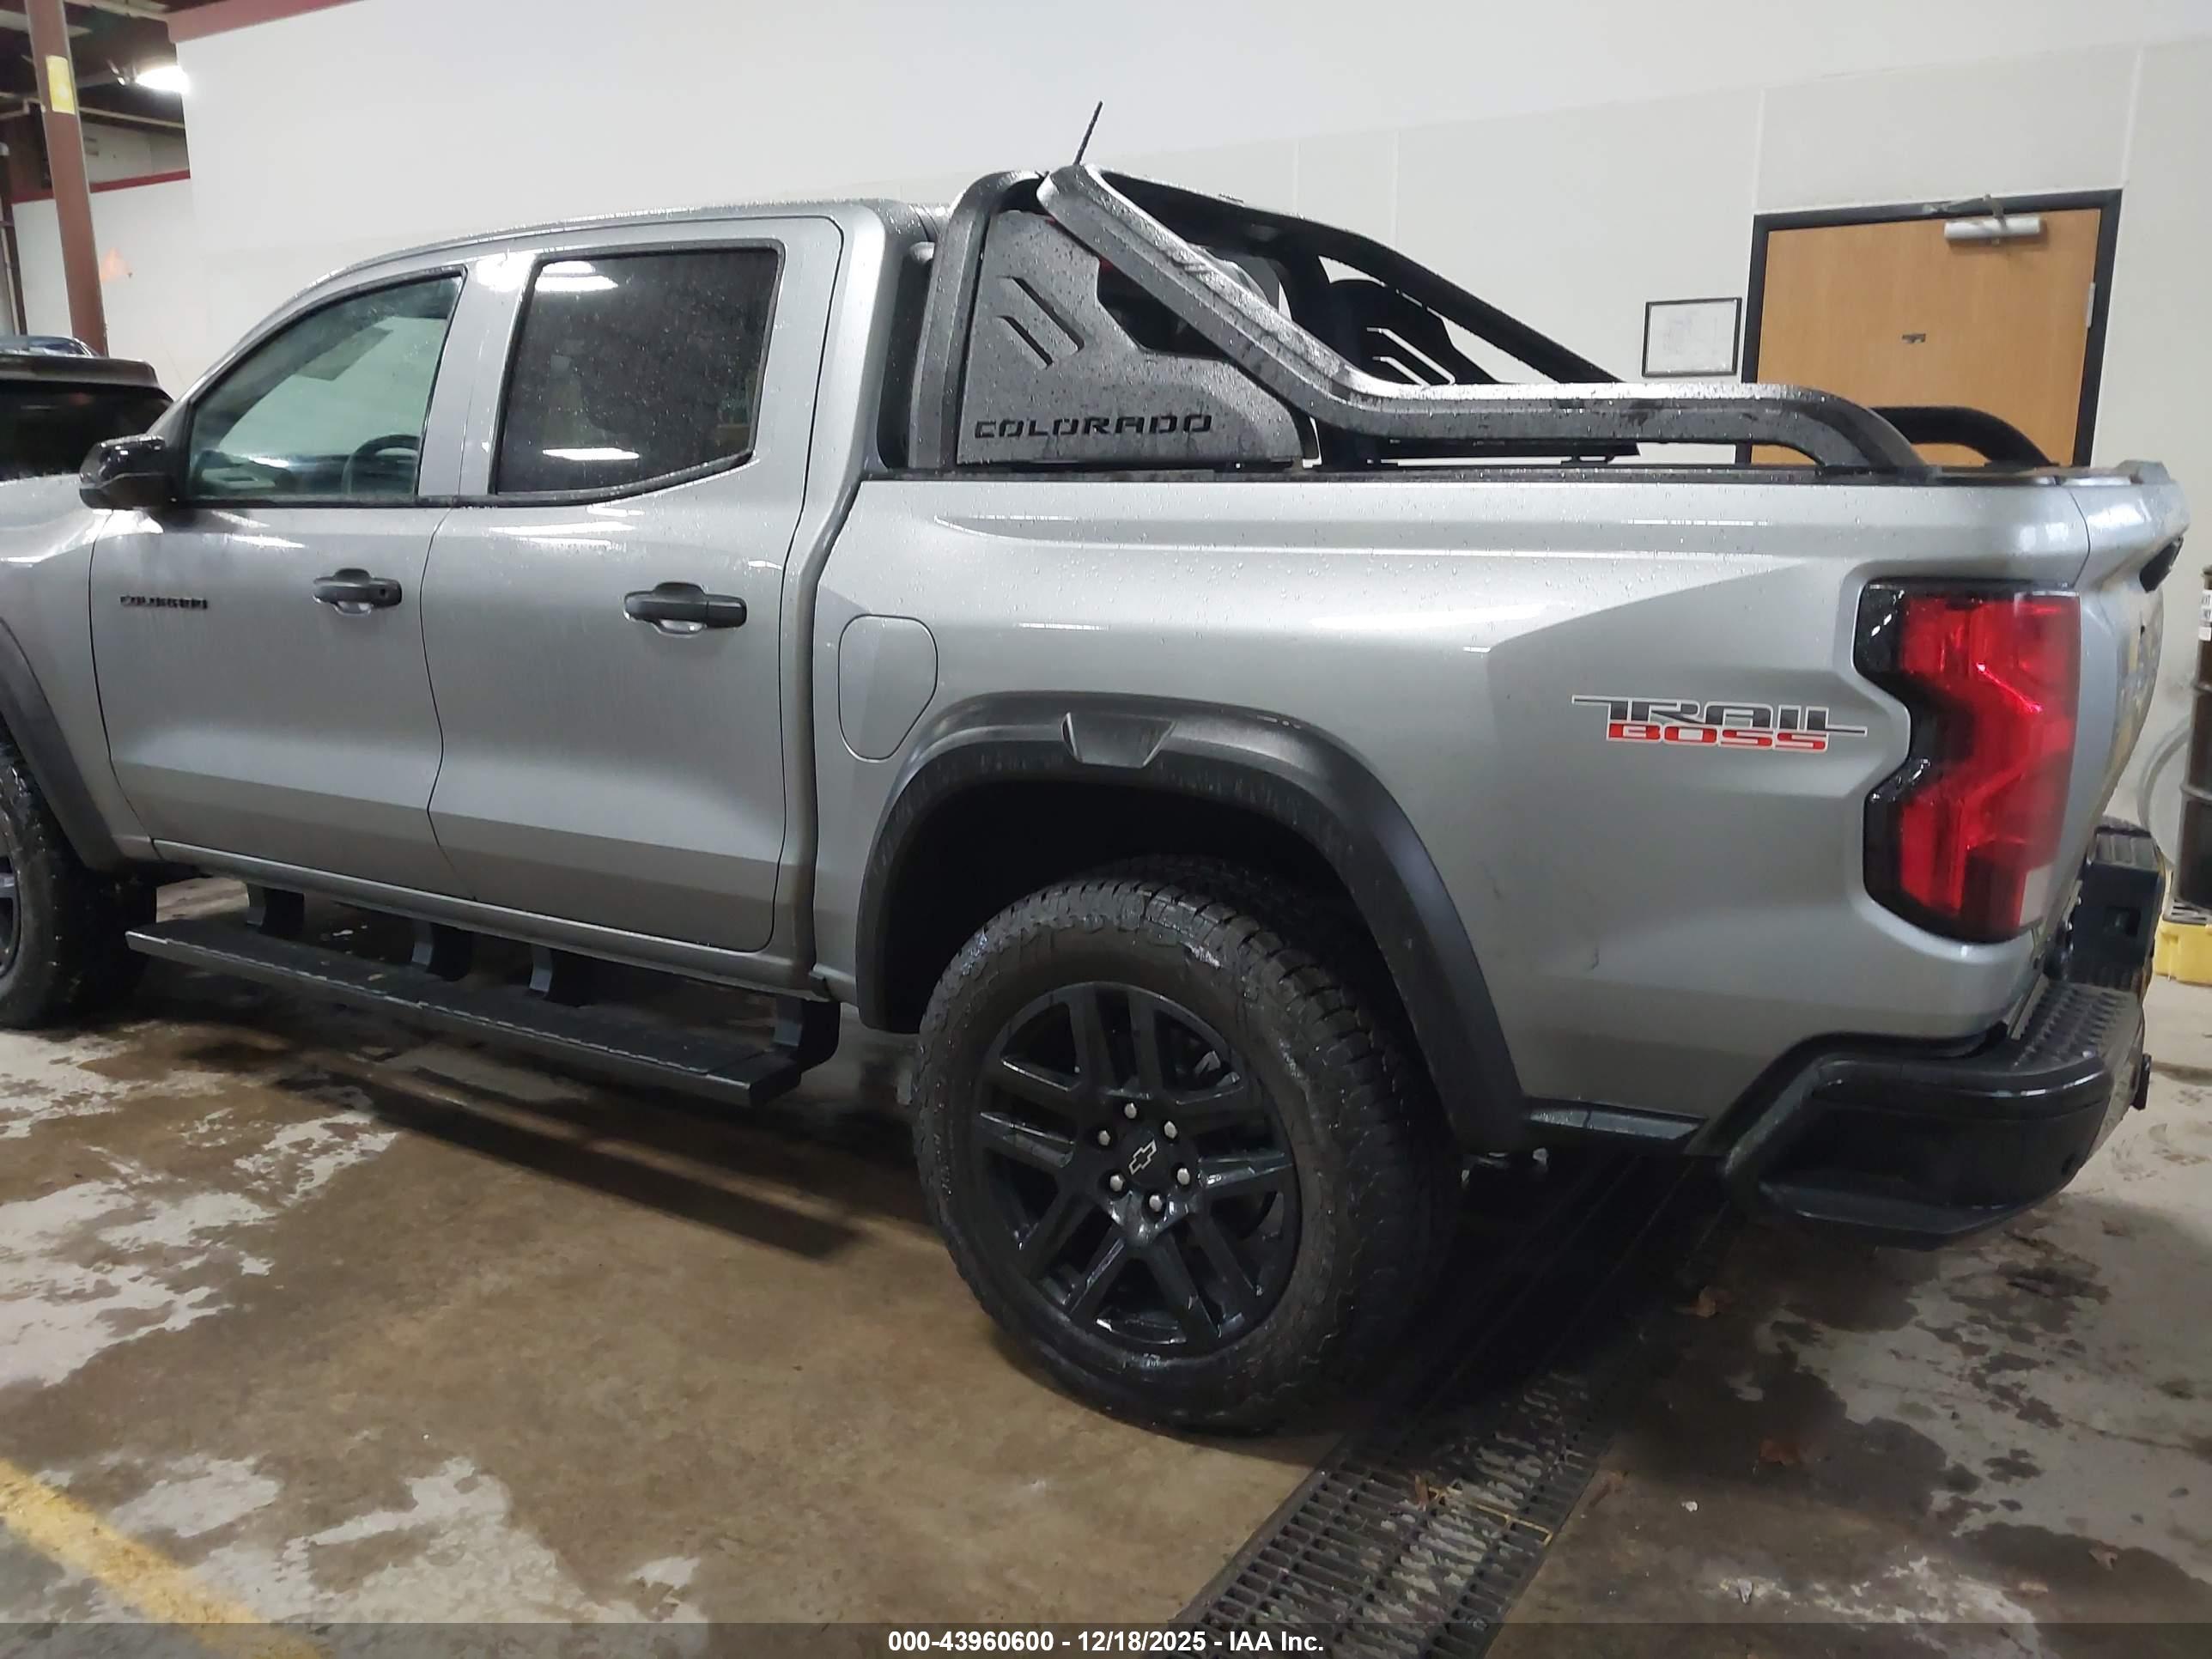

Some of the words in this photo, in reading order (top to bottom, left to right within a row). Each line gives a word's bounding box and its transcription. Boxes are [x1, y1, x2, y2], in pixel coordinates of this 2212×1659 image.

[974, 413, 1212, 439] COLORADO
[1571, 694, 1868, 737] TRAIL
[1606, 721, 1830, 753] BOSS
